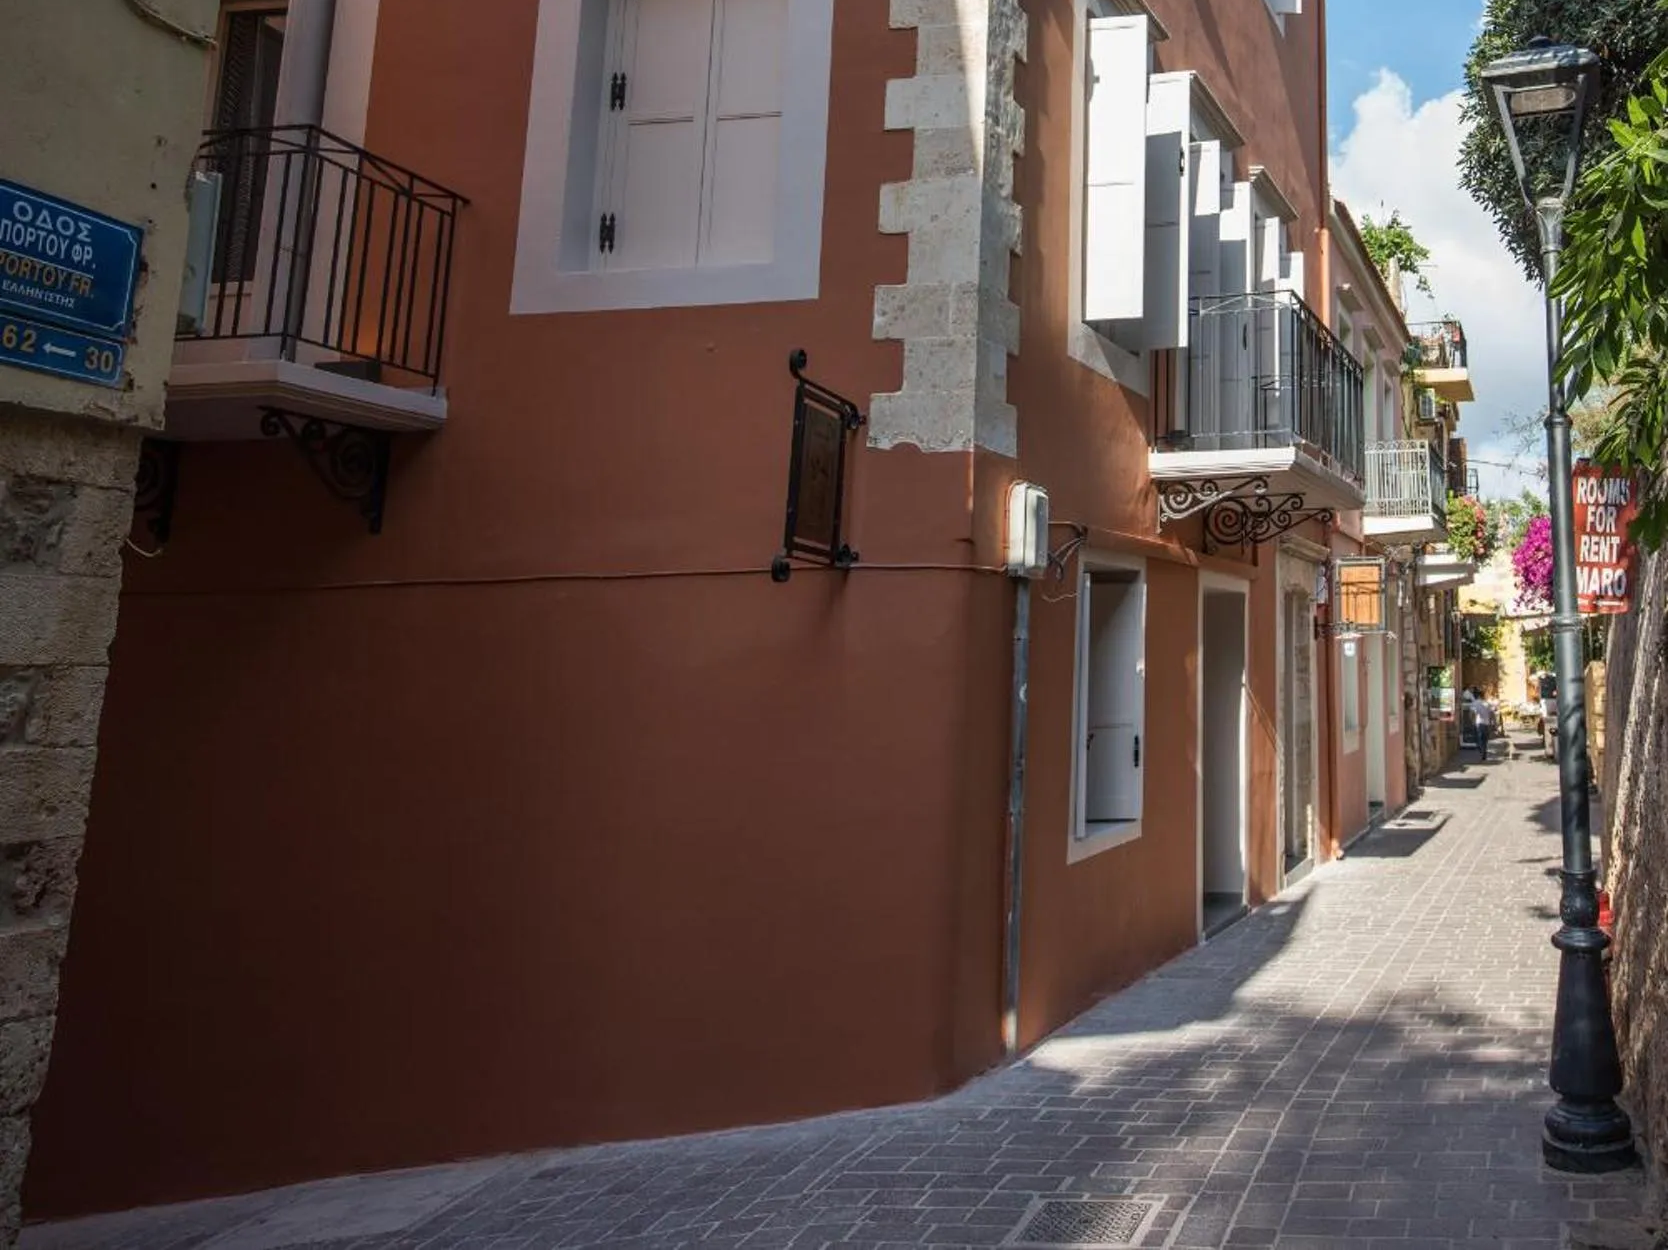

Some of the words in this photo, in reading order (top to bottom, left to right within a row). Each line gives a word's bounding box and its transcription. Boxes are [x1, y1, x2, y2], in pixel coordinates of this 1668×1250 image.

[13, 201, 92, 242] ΟΔΟΣ
[0, 217, 70, 259] ΠΟΡΤΟΥ
[71, 242, 96, 269] ΦΡ.
[2, 324, 37, 353] 62
[84, 346, 114, 373] 30
[1576, 476, 1631, 506] ROOMS
[1586, 505, 1617, 534] FOR
[1579, 535, 1621, 564] RENT
[1576, 565, 1627, 598] MARO
